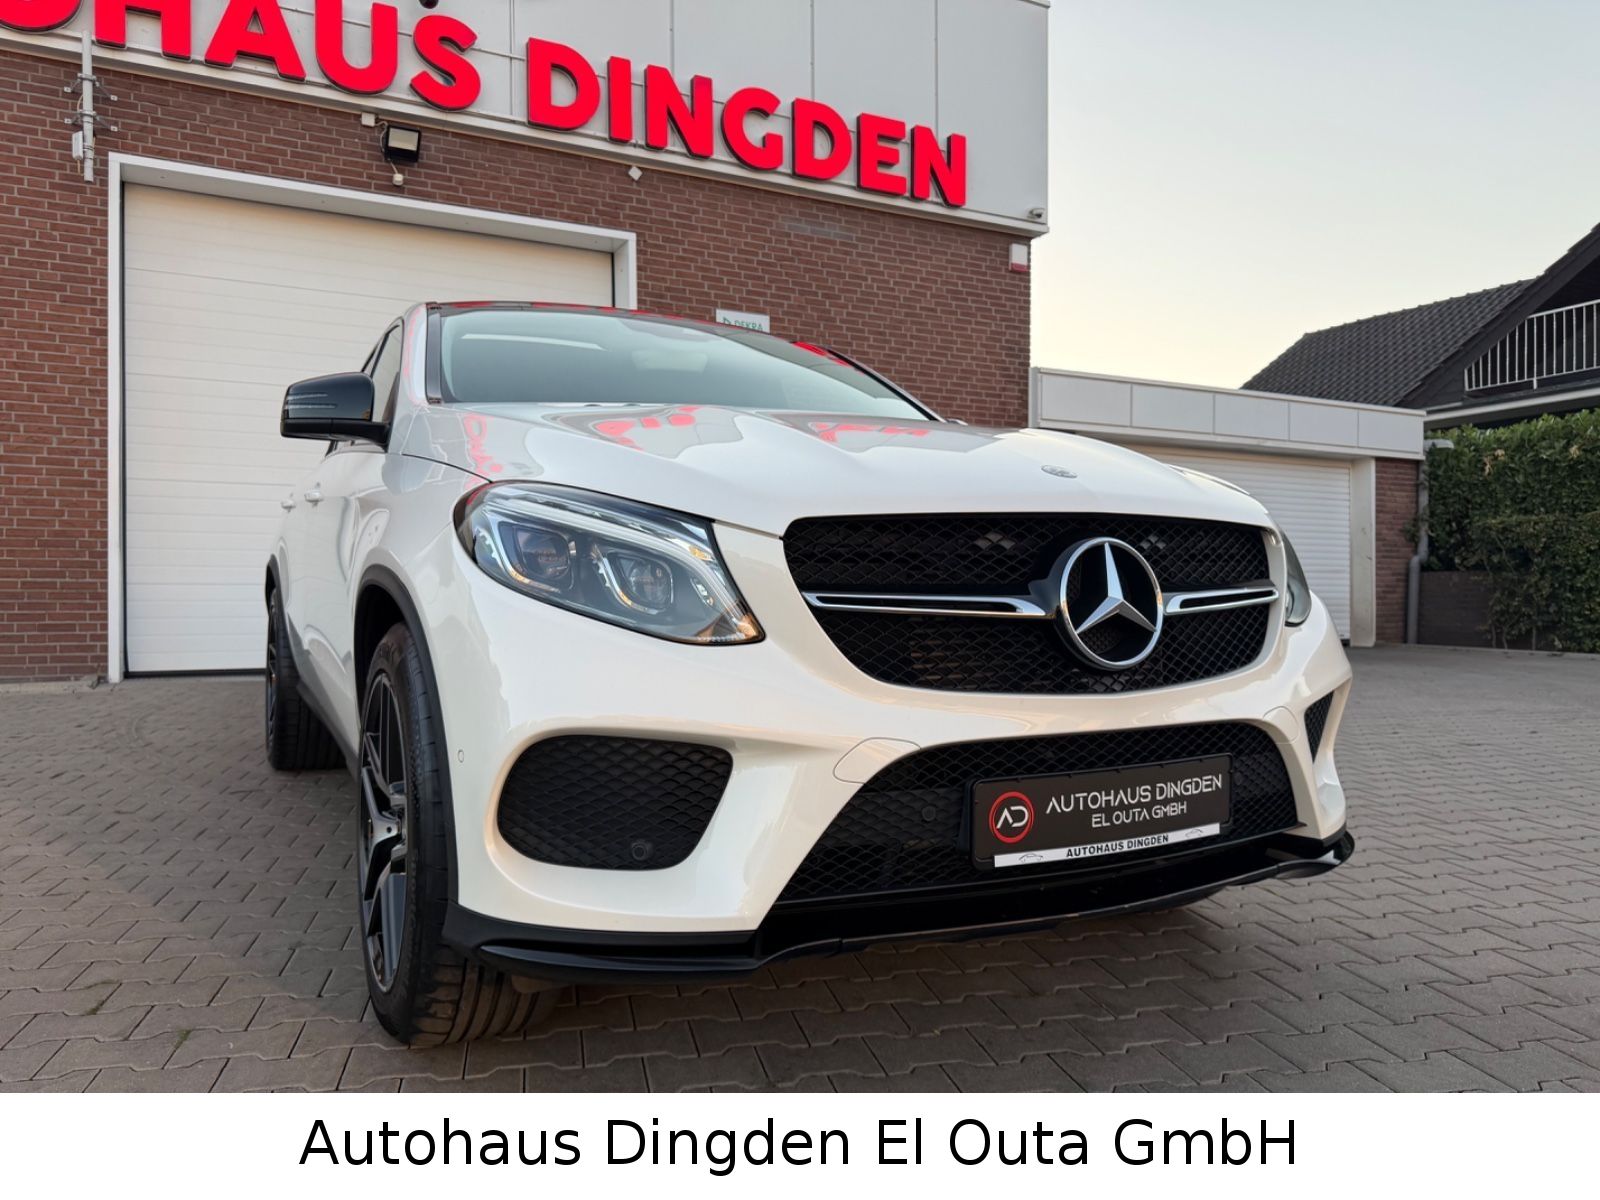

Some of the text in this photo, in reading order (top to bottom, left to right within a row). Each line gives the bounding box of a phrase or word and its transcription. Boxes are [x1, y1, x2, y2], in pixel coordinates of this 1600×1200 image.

[526, 37, 967, 207] DINGDEN
[1046, 774, 1223, 814] AUTOHAUS DINGDEN
[1091, 802, 1187, 828] EL OUTA GMBH
[1066, 834, 1169, 858] AUTOHAUS DINGDEN
